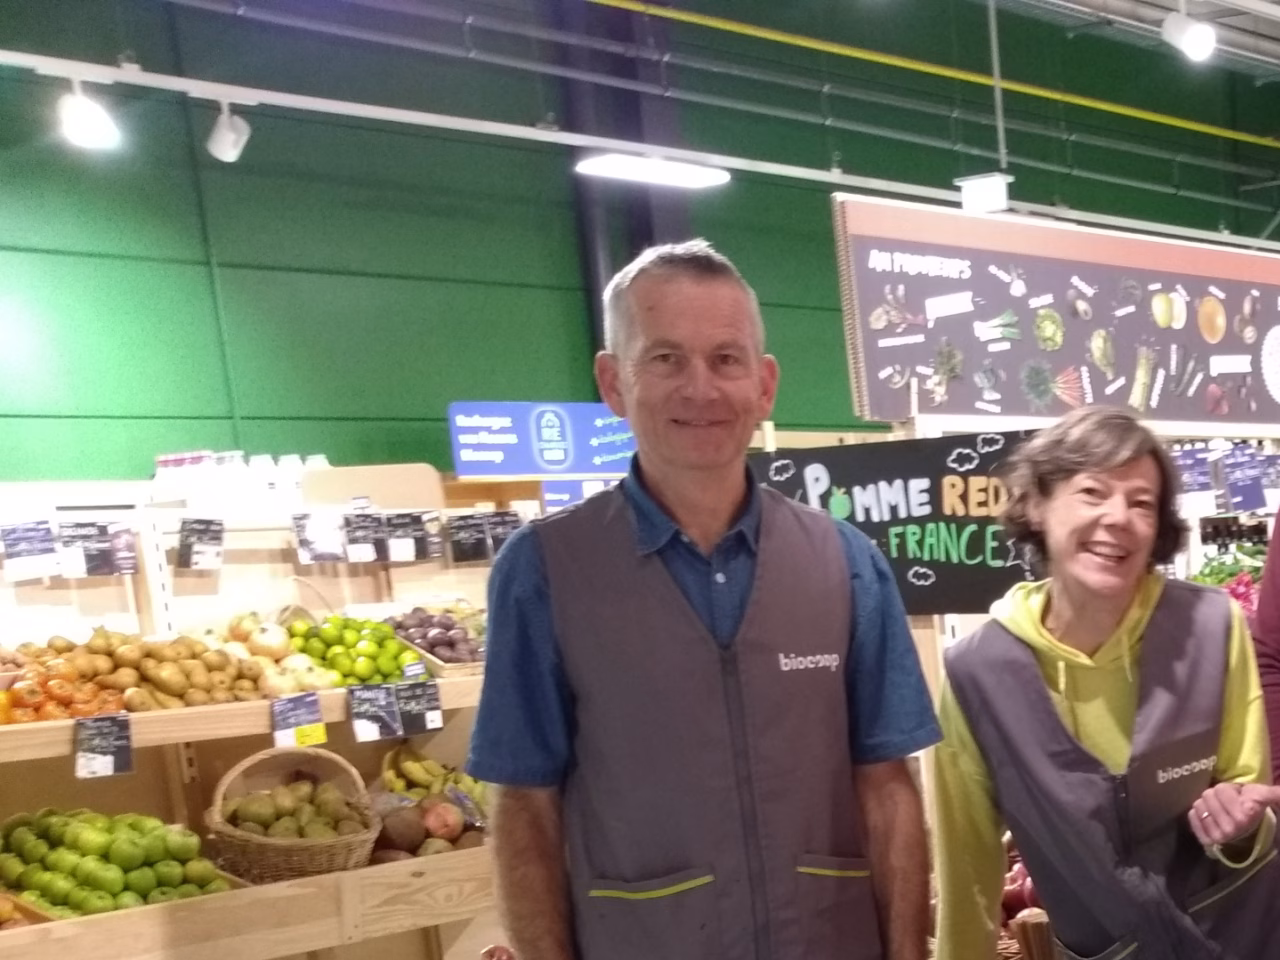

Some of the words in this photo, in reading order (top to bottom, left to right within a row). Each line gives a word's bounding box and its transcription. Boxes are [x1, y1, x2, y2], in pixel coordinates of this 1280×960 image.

[888, 521, 1005, 568] FRANCE
[778, 653, 840, 672] biocoop
[1156, 755, 1218, 784] biocoop
